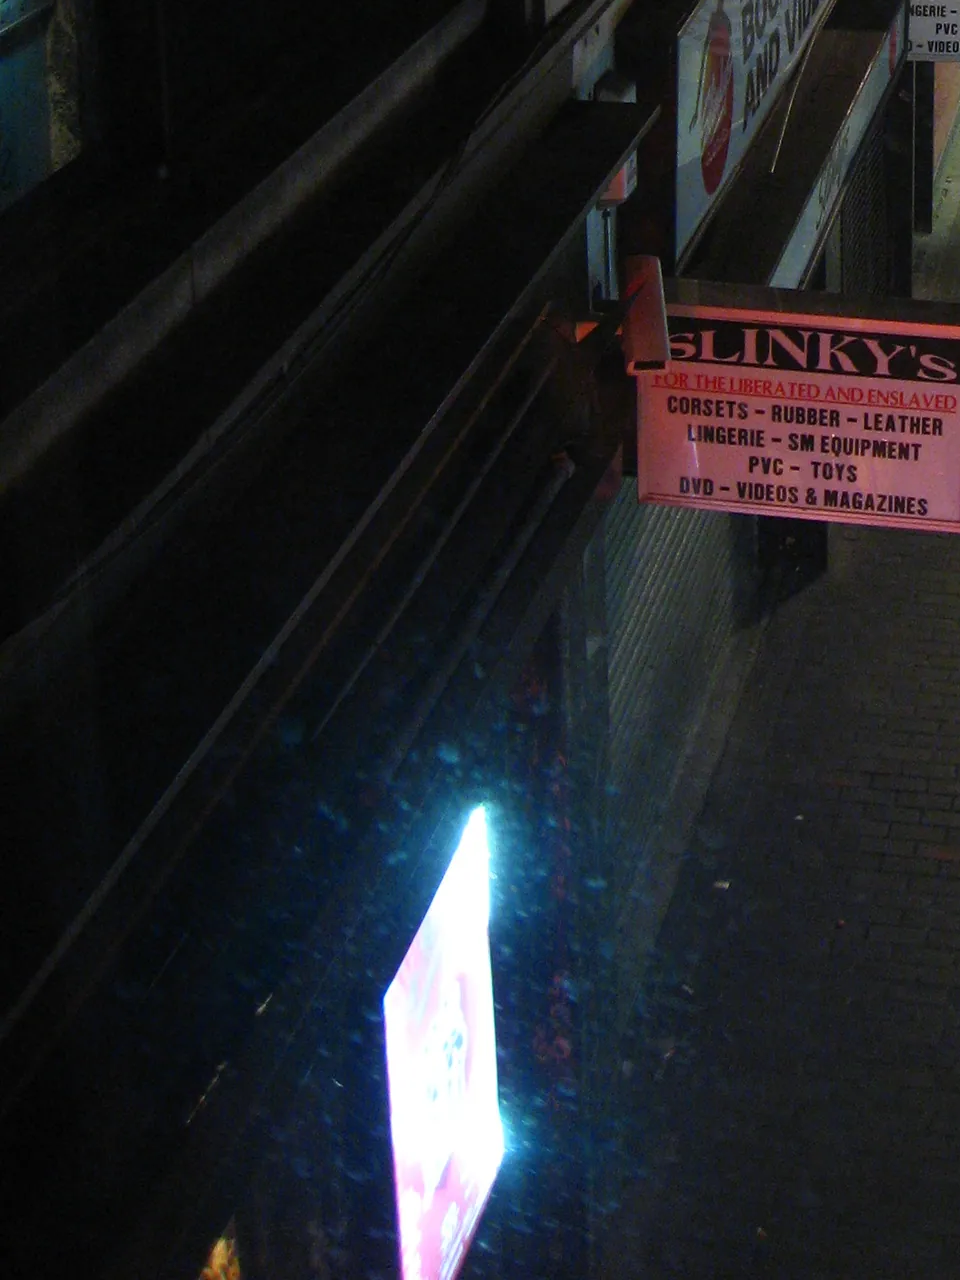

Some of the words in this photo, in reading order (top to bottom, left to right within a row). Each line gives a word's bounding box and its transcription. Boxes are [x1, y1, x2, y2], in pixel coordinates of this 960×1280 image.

[936, 23, 958, 36] PVC
[743, 29, 780, 132] AND
[669, 328, 958, 381] SLINKY'S
[653, 371, 689, 388] FOR
[694, 373, 726, 390] THE
[729, 378, 821, 400] LIBERATED
[825, 386, 863, 404] AND
[867, 388, 957, 410] ENSLAVED
[667, 395, 749, 420] CORSETS
[771, 404, 841, 428] RUBBER
[863, 412, 944, 436] LEATHER
[687, 424, 766, 447] LINGERIE
[788, 435, 814, 453] SM
[820, 436, 922, 462] EQUIPMENT
[748, 455, 784, 475] PVC
[811, 461, 858, 483] TOYS
[679, 477, 714, 496] DVD
[737, 481, 799, 505] VIDEOS
[805, 488, 817, 505] &
[823, 488, 929, 516] MAGAZINES
